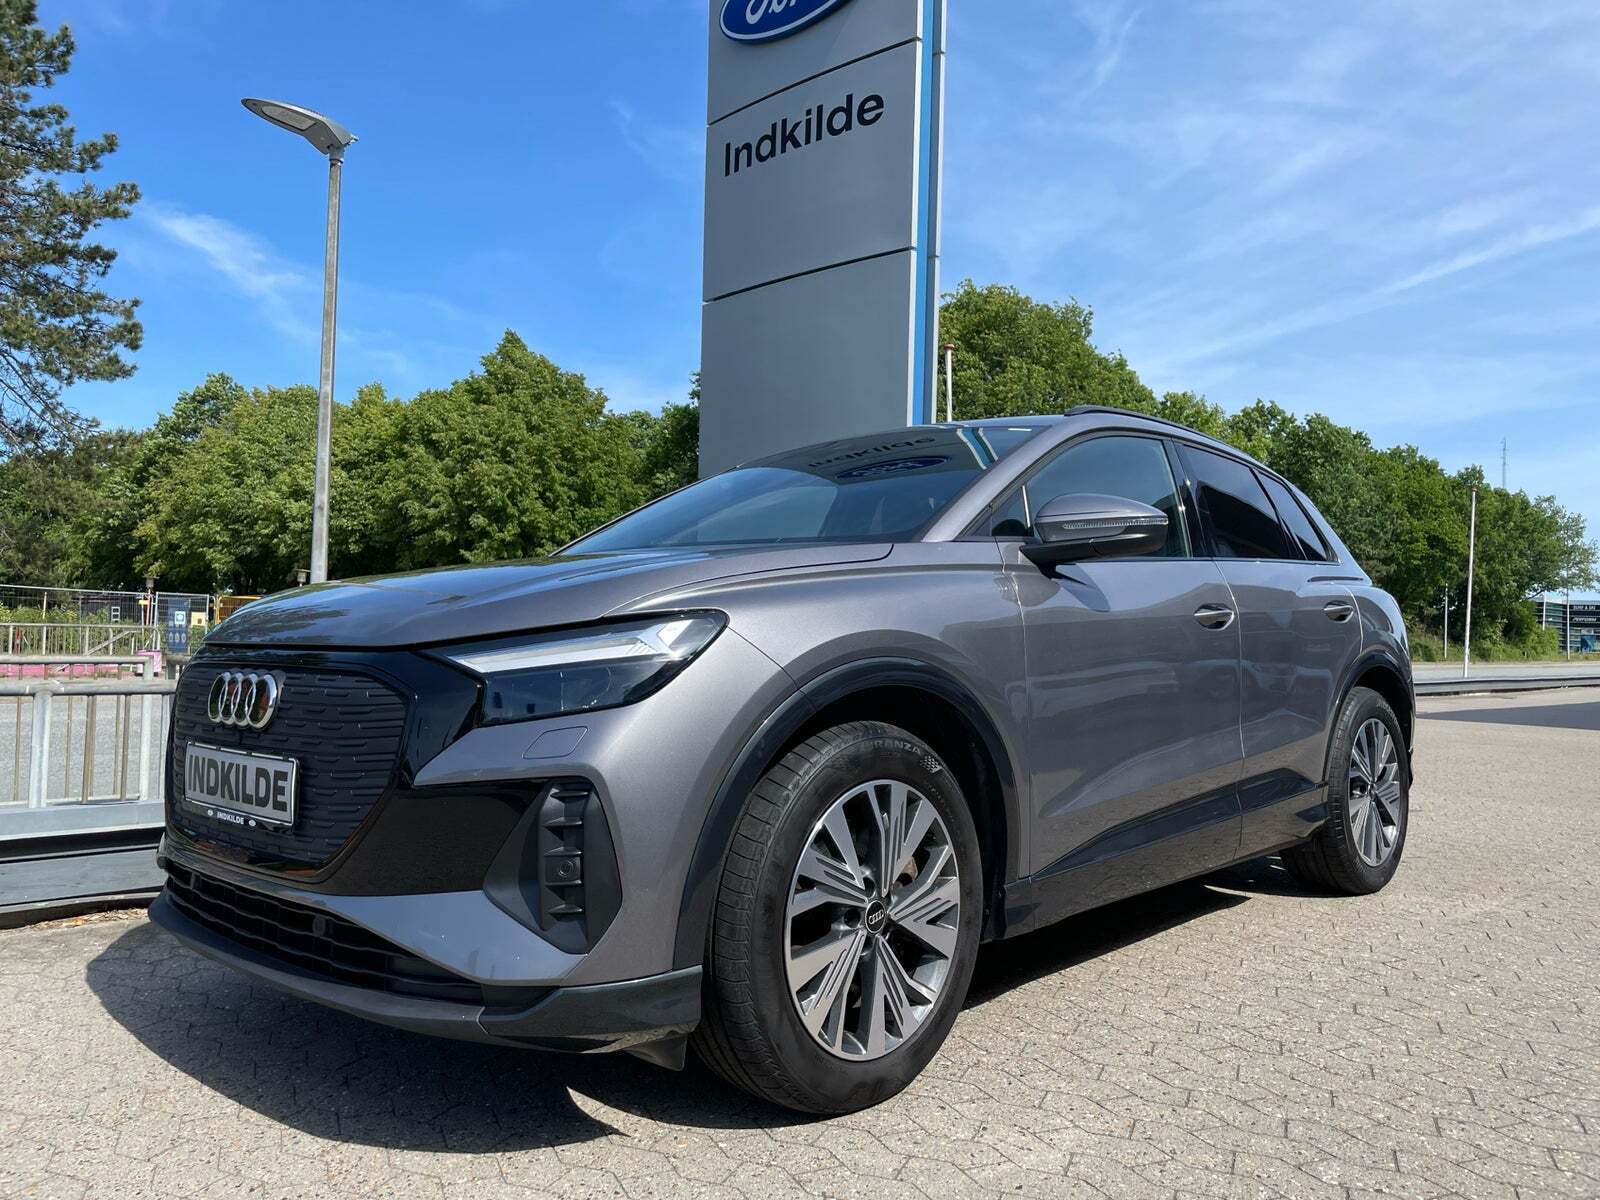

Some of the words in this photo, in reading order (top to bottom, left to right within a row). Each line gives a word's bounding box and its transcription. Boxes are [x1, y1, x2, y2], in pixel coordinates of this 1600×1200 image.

[724, 93, 885, 177] Indkilde
[188, 754, 289, 813] INDKILDE
[216, 811, 245, 825] INDKILDE
